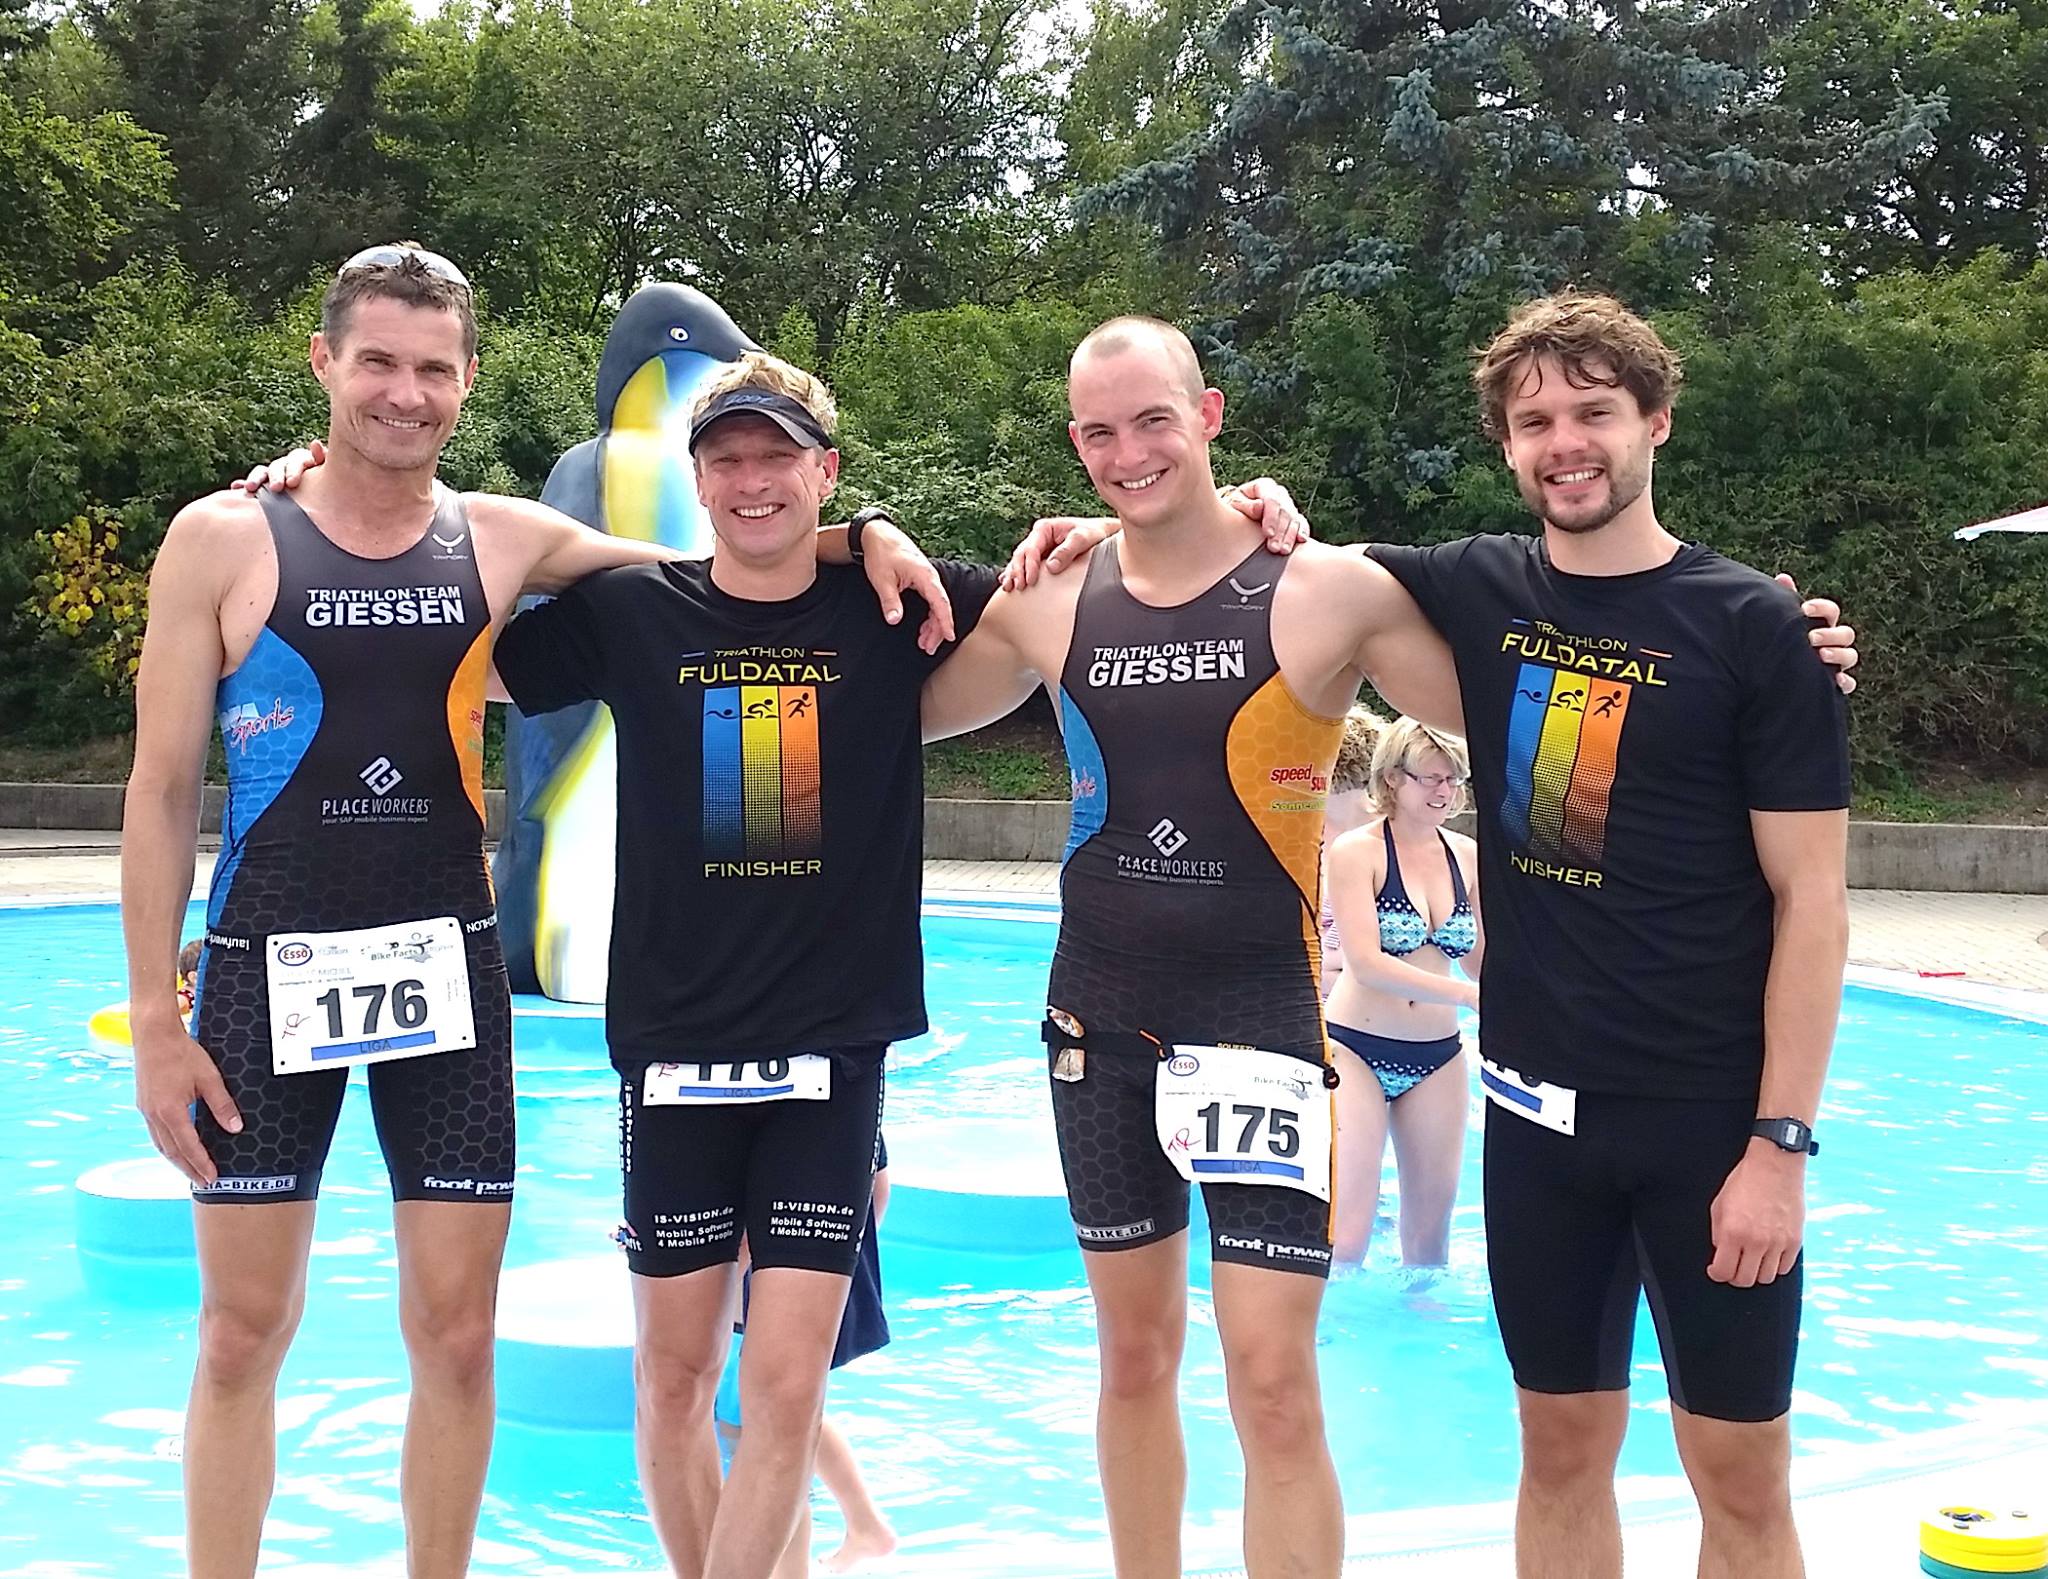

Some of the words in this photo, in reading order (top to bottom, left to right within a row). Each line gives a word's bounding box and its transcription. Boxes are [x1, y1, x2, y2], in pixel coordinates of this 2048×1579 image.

[306, 586, 461, 602] TRIATHLON-TEAM
[305, 600, 465, 626] GIESSEN
[714, 647, 805, 658] TRIATHLON
[1093, 639, 1244, 661] TRIATHLON-TEAM
[1501, 632, 1667, 686] FULDATAL
[679, 662, 841, 684] FULDATAL
[1088, 653, 1245, 686] GIESSEN
[1271, 764, 1312, 784] speed
[704, 860, 822, 878] FINISHER
[394, 949, 418, 958] Facts
[317, 979, 428, 1038] 176
[360, 1040, 392, 1053] LIGA
[1197, 1102, 1300, 1158] 175
[423, 1177, 475, 1190] foot
[654, 1206, 734, 1224] IS-VISION.de
[773, 1201, 854, 1216] IS-VISION.de
[656, 1229, 694, 1238] Mobile
[698, 1221, 733, 1235] Software
[771, 1217, 802, 1226] Mobile
[806, 1218, 851, 1231] Software
[658, 1240, 664, 1248] 4
[668, 1237, 705, 1248] Mobile
[708, 1229, 733, 1243] People
[770, 1227, 775, 1235] 4
[777, 1227, 811, 1237] Mobile
[814, 1229, 848, 1241] People
[1218, 1235, 1265, 1250] foot
[1266, 1243, 1330, 1260] power
